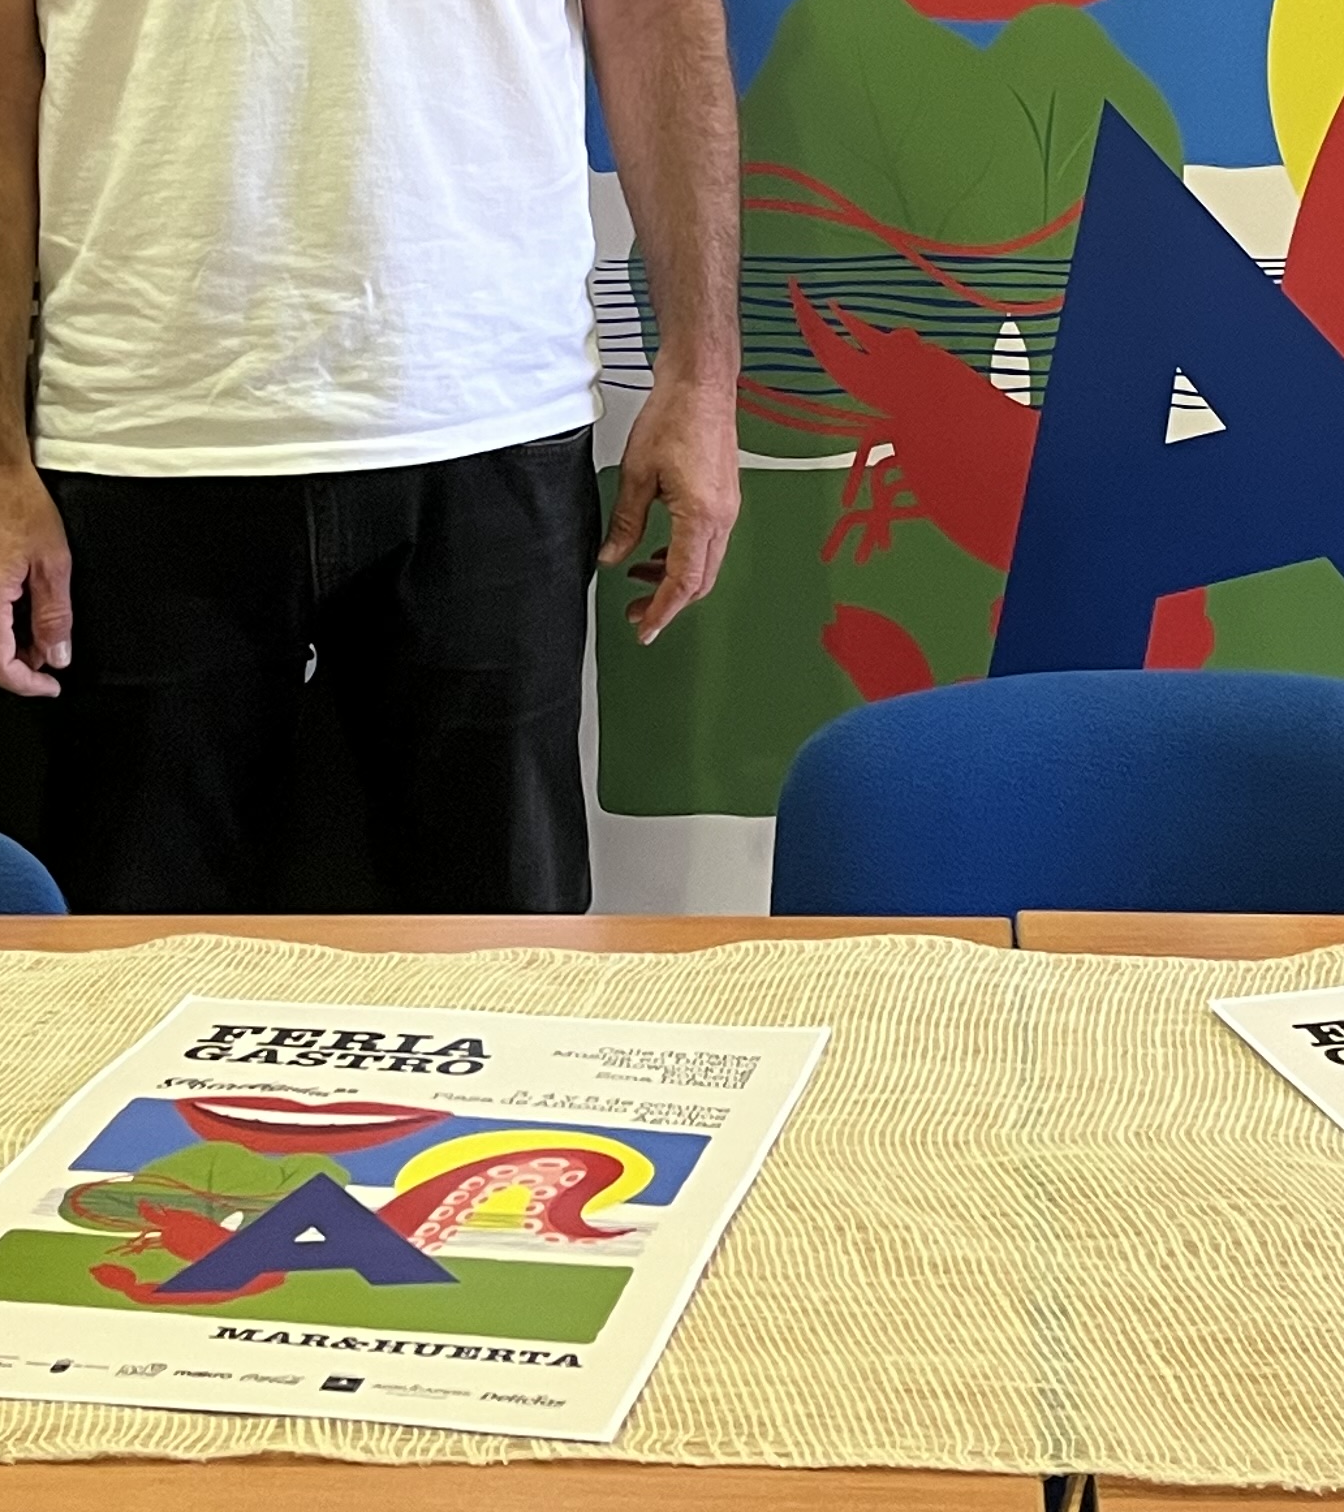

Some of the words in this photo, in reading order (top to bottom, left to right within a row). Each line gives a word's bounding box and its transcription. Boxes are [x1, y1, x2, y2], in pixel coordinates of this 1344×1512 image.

[197, 1024, 491, 1059] FERIA
[183, 1044, 484, 1076] GASTRO
[208, 1325, 584, 1369] MAR&HUERTA
